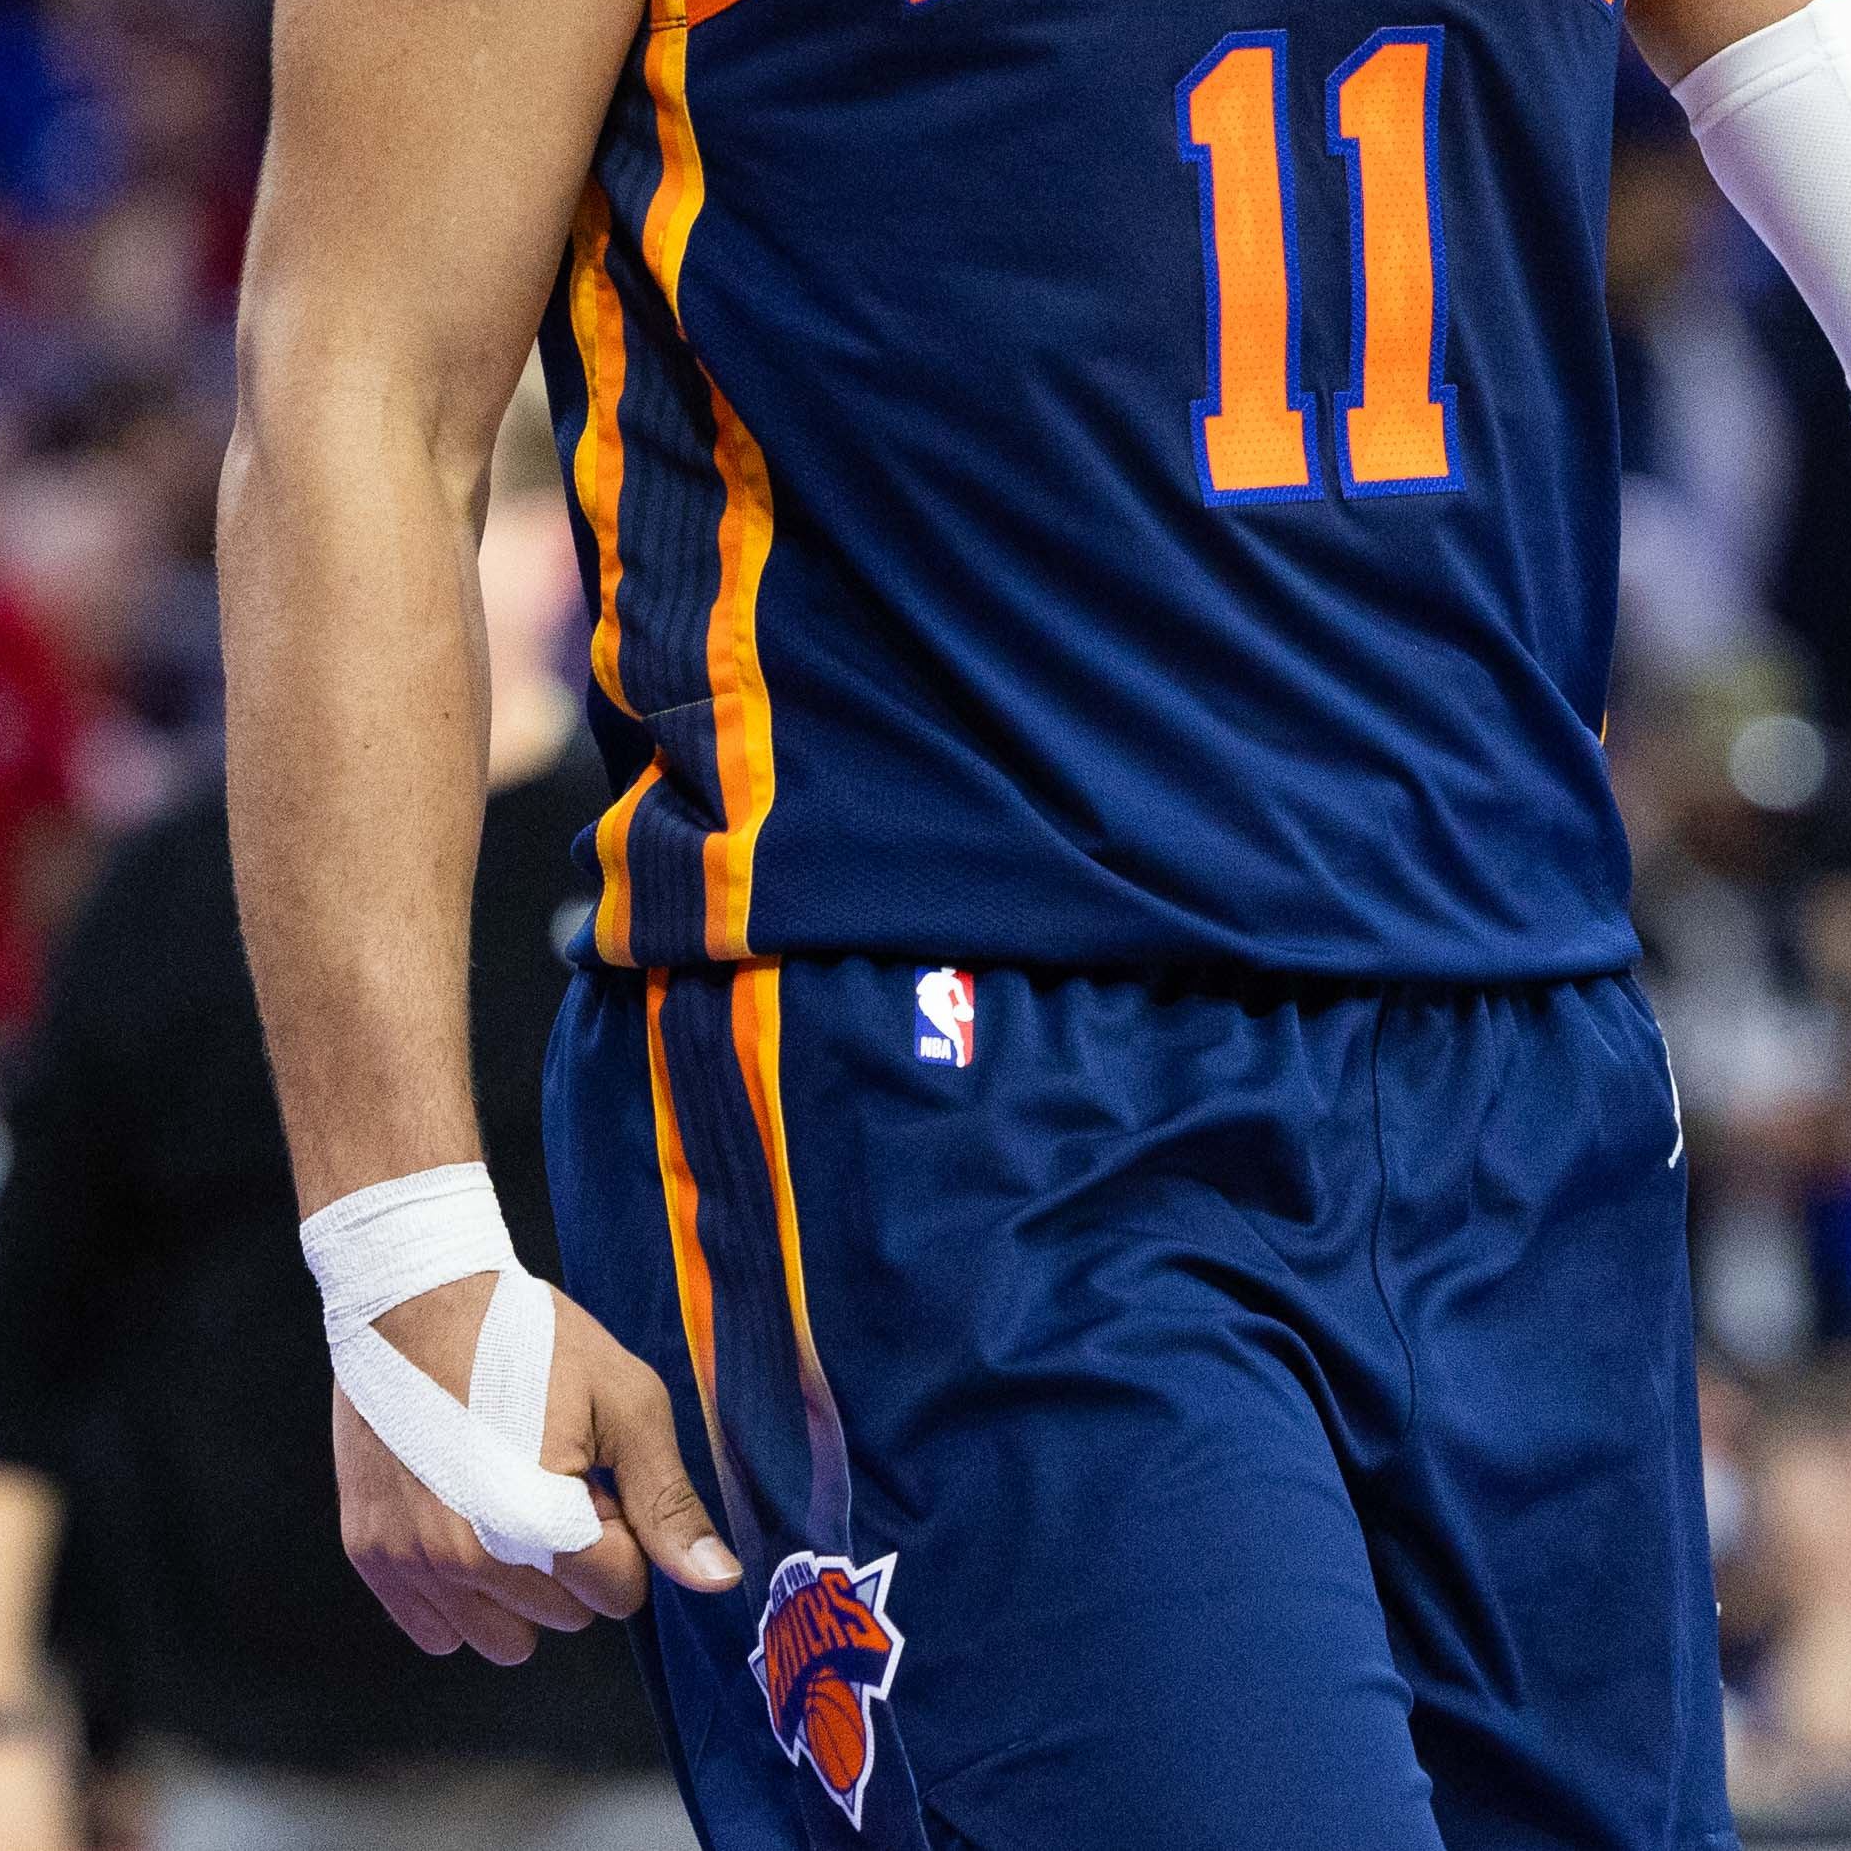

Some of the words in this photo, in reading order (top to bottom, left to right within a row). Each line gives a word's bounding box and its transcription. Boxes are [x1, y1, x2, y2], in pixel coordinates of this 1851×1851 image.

[1175, 23, 1467, 508] 11
[920, 1036, 952, 1060] NBA
[763, 1566, 892, 1734] KNICKS
